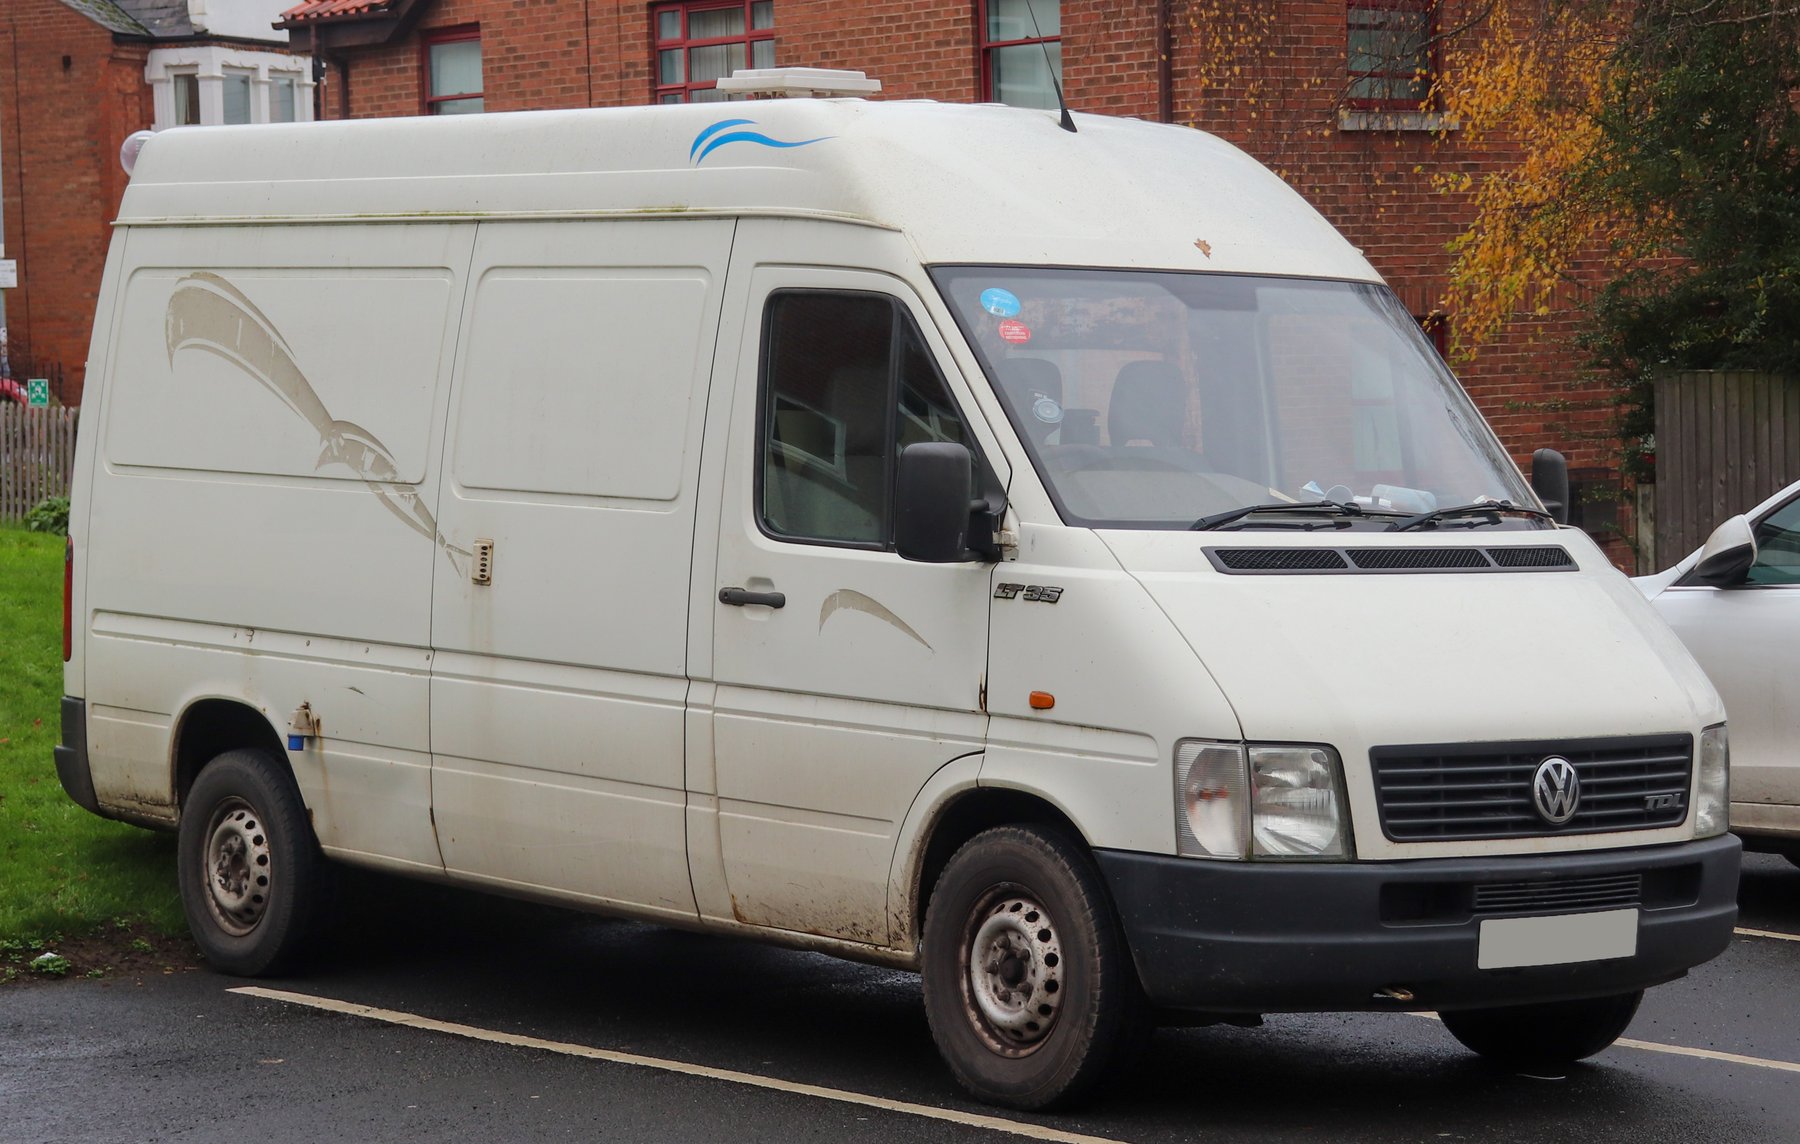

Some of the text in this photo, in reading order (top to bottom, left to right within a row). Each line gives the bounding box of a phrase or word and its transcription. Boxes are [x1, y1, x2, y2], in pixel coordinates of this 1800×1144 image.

[994, 583, 1064, 604] LT 35
[1533, 757, 1580, 823] VW
[1645, 793, 1682, 810] TDI
